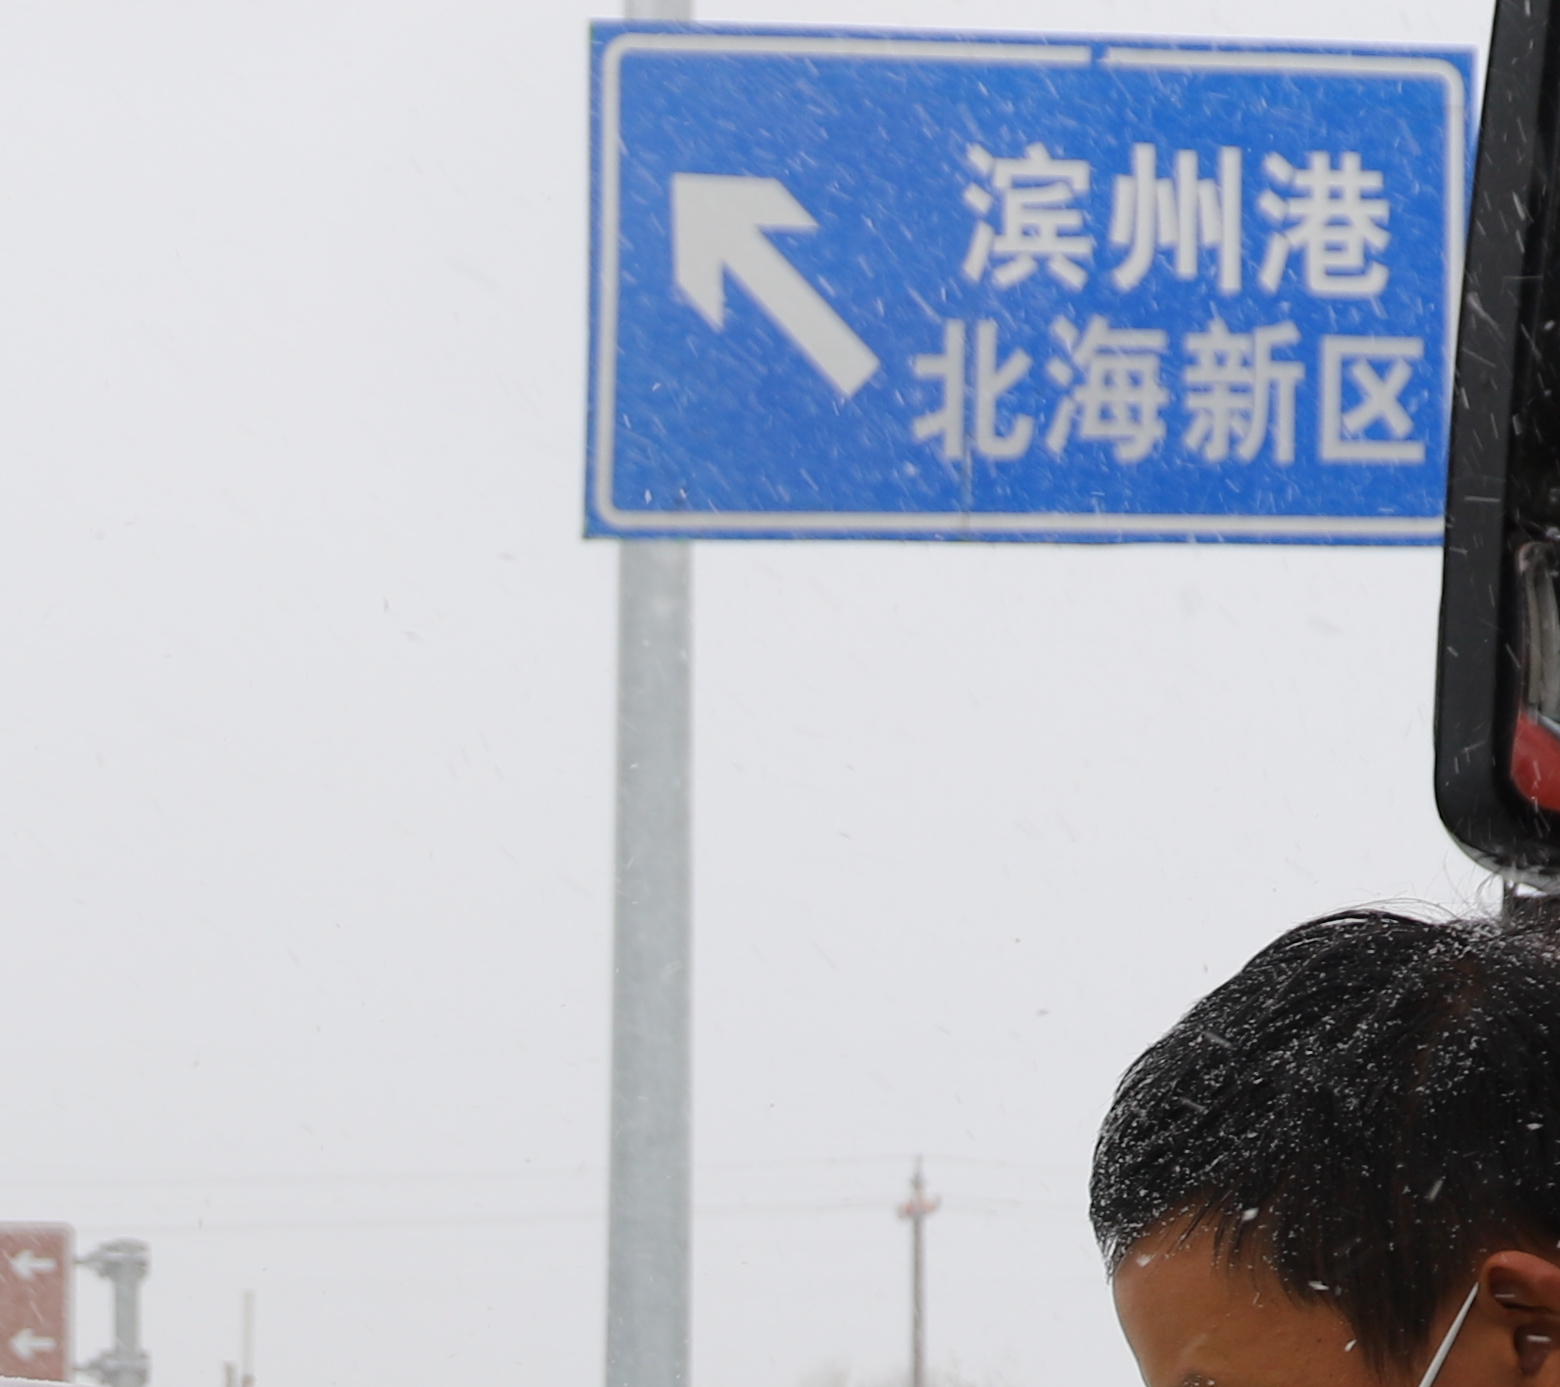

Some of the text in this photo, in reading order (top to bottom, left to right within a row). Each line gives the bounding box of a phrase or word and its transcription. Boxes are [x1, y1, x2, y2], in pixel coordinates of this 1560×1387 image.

[962, 143, 1391, 299] 滨州港
[913, 317, 1425, 466] 北海新区
